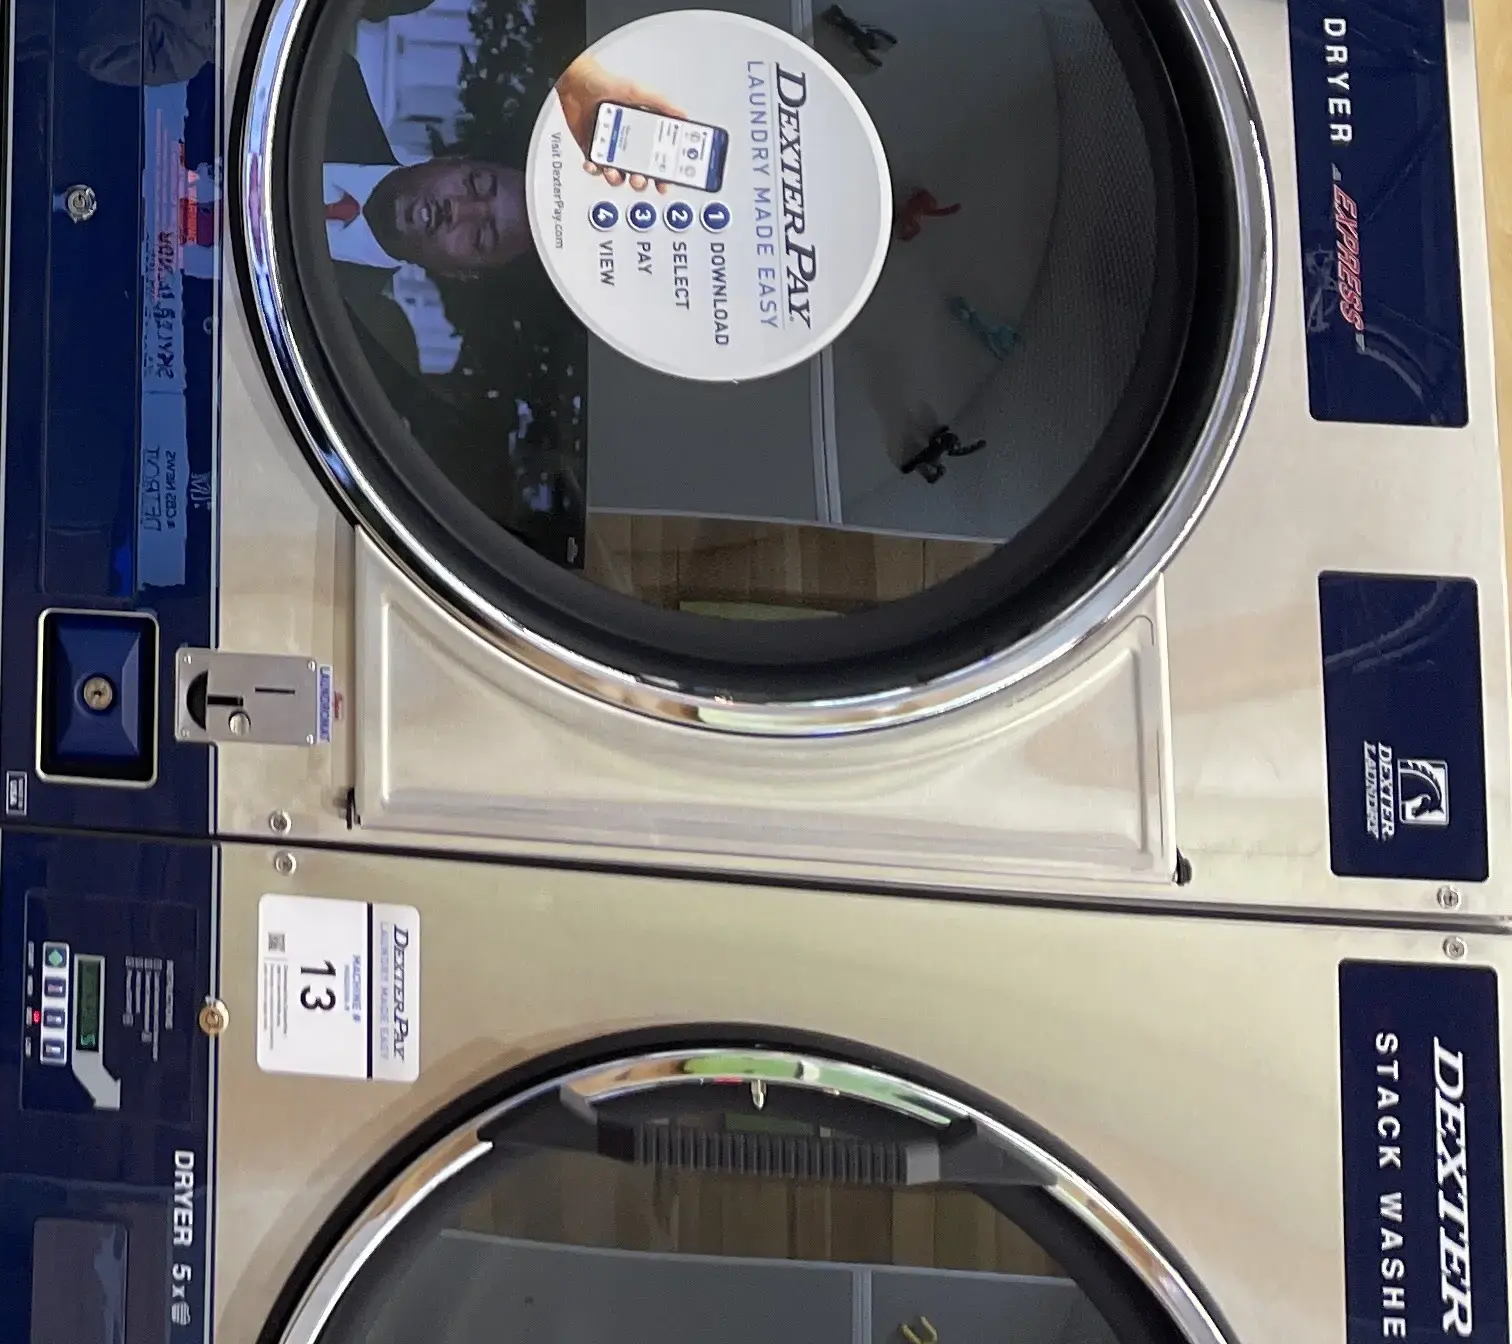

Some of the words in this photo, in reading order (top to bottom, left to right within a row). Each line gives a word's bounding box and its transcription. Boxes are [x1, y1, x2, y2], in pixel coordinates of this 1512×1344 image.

[746, 60, 771, 176] LAUNDRY
[1322, 18, 1353, 144] DRYER
[550, 132, 562, 159] Visit
[550, 161, 565, 249] DexterPay.com
[755, 187, 774, 256] MADE
[599, 240, 615, 287] VIEW
[637, 241, 652, 275] PAY
[672, 241, 690, 310] SELECT
[710, 242, 729, 346] DOWNLOAD
[758, 266, 779, 330] EASY
[1333, 184, 1364, 331] EXPRESS
[1363, 741, 1380, 838] LAUNDRY
[1378, 742, 1395, 840] DEXTER
[300, 960, 336, 1011] 13
[1375, 1033, 1403, 1170] STACK
[173, 1150, 194, 1245] DRYER
[1432, 1037, 1473, 1338] DEXTER
[172, 1263, 191, 1280] 5
[172, 1285, 185, 1298] x
